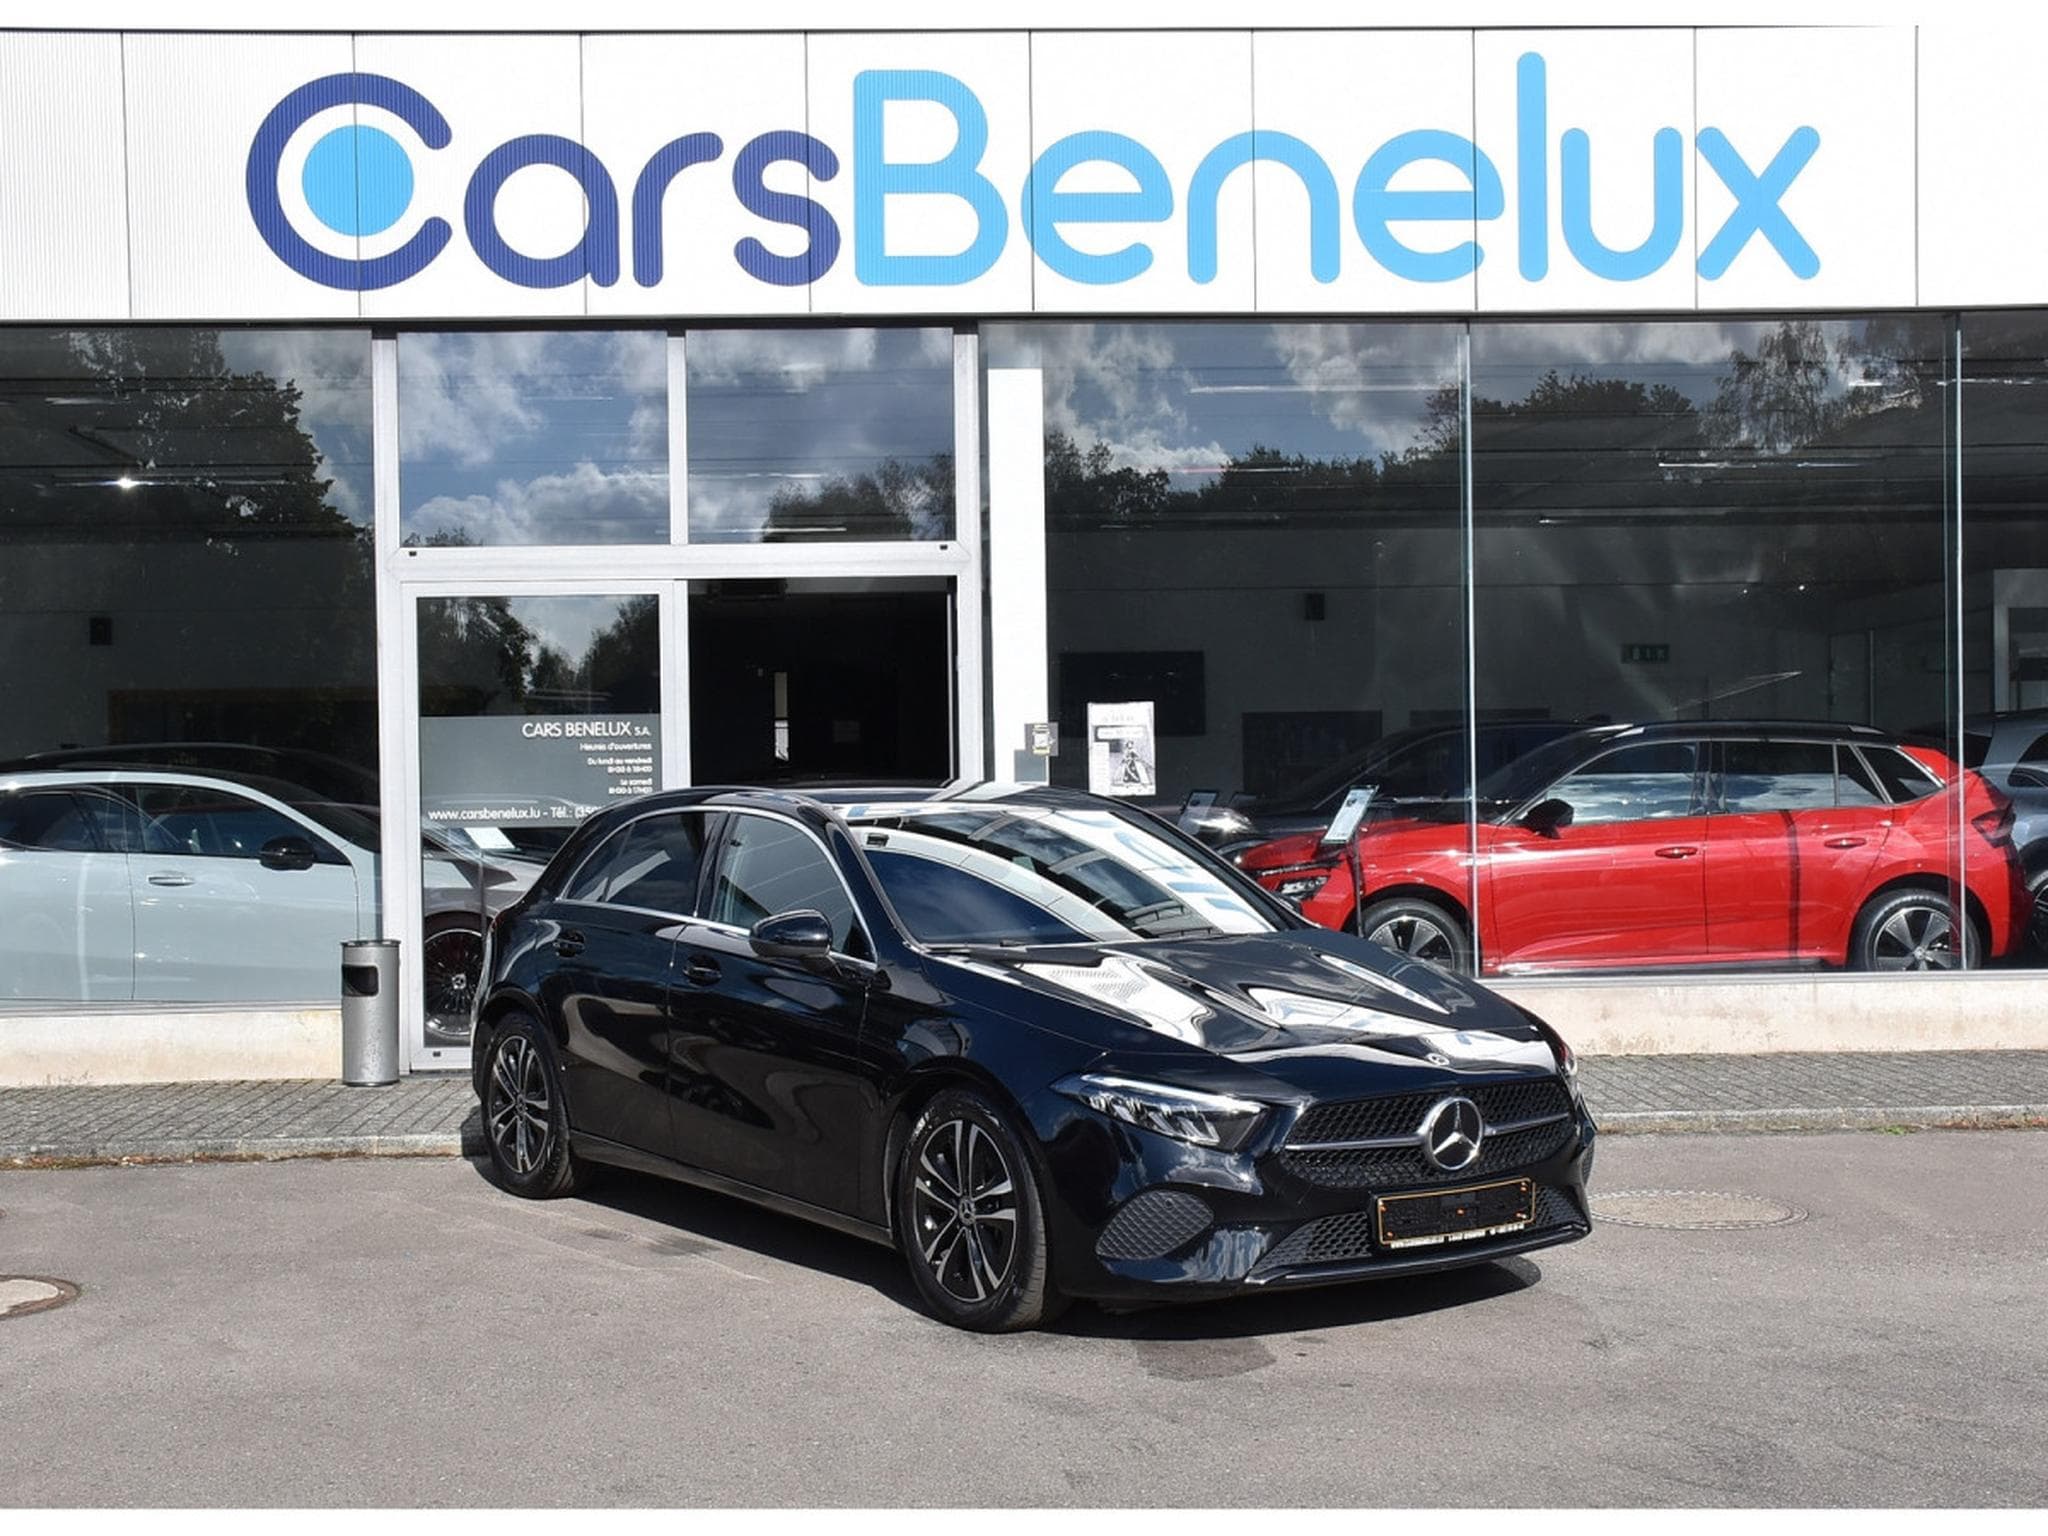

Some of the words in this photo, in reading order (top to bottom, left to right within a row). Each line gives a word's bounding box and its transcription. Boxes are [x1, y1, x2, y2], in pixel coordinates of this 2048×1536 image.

[522, 722, 562, 738] CARS
[565, 721, 632, 737] BENELUX
[579, 742, 607, 752] Heures
[428, 806, 540, 821] www.carsbenelux.lu
